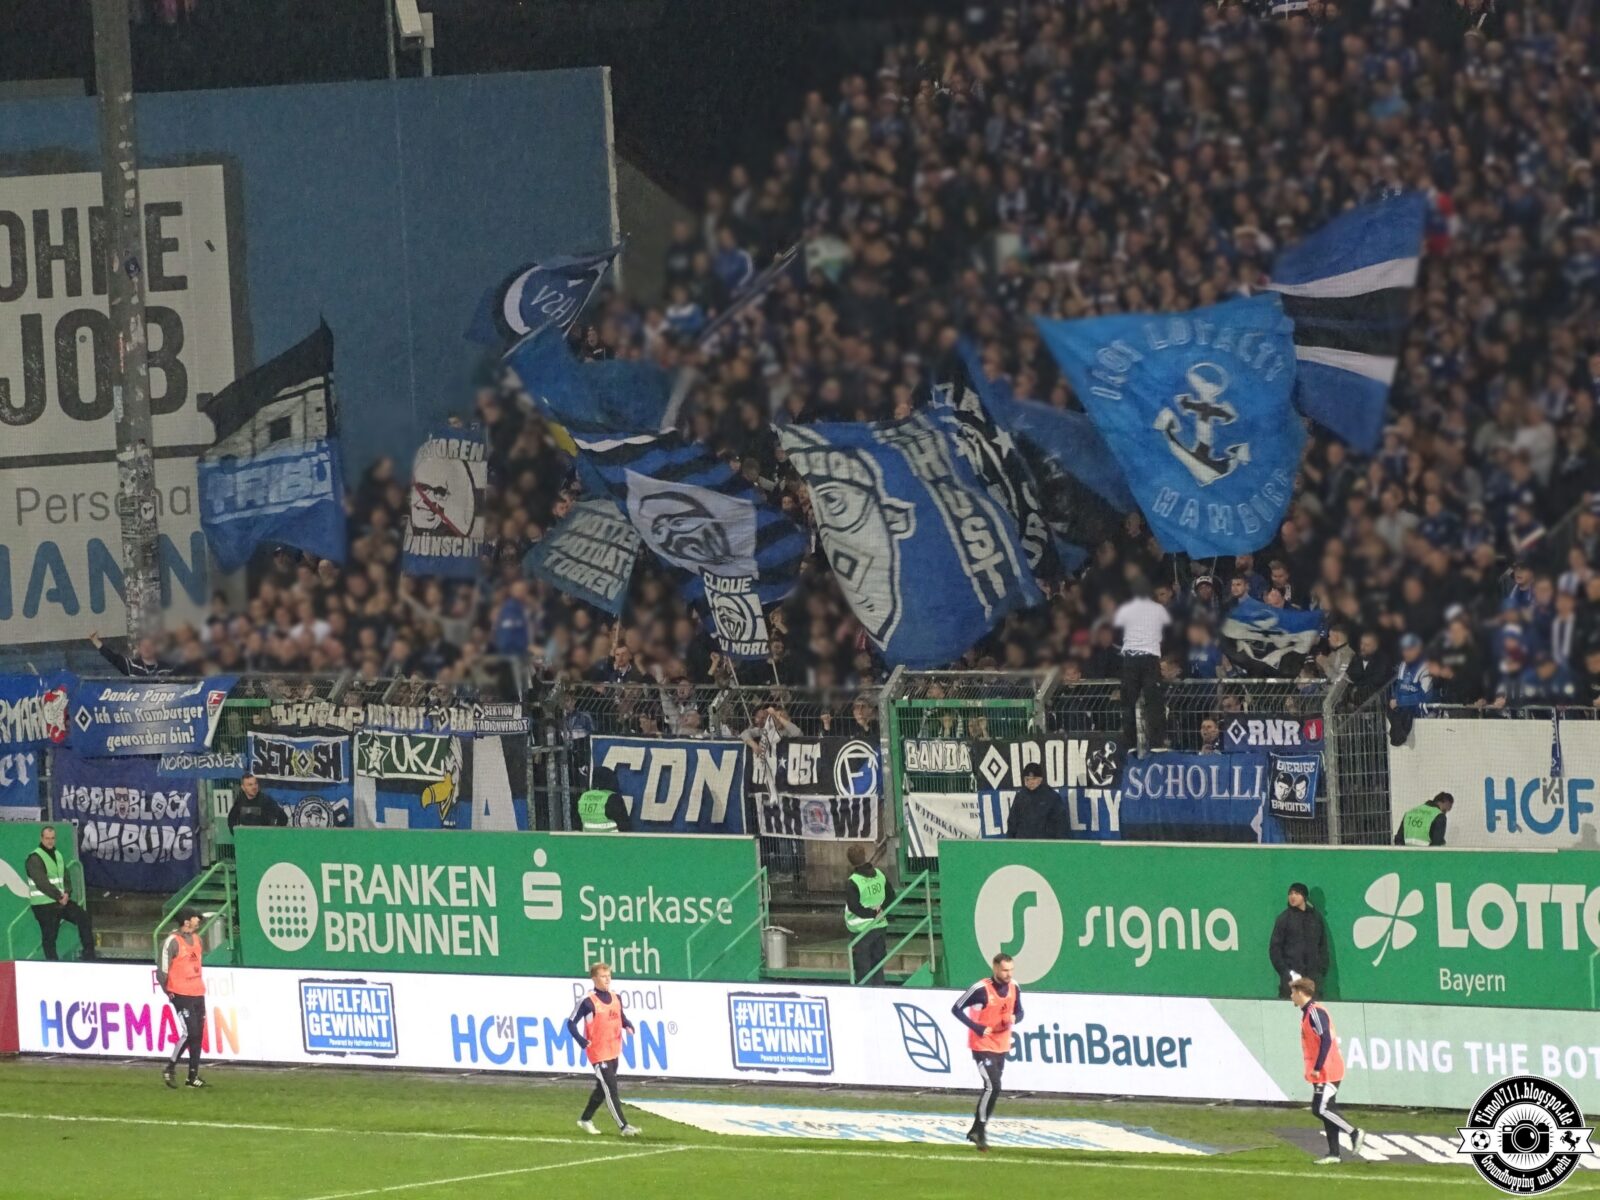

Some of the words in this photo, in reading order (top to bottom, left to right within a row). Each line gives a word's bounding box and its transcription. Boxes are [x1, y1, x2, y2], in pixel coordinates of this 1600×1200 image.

[99, 688, 140, 702] Danke
[142, 690, 176, 705] Papa
[94, 705, 111, 724] ich
[114, 707, 132, 724] ein
[134, 704, 203, 724] Hamburger
[107, 727, 167, 751] geworden
[170, 725, 195, 744] bin!
[1247, 719, 1301, 745] RNR
[905, 740, 972, 772] BANDA
[1124, 763, 1264, 800] SCHOLLI
[81, 820, 193, 864] AMBURG
[320, 862, 497, 908] FRANKEN
[579, 884, 733, 931] Sparkasse
[324, 911, 500, 957] BRUNNEN
[1078, 905, 1239, 968] signia
[582, 937, 661, 975] Fürth
[1439, 967, 1506, 997] Bayern
[306, 988, 388, 1014] #VIELFALT
[736, 1002, 823, 1029] #VIELFALT
[308, 1012, 389, 1038] GEWINNT
[738, 1027, 825, 1054] GEWINNT
[1009, 1023, 1192, 1069] artinBauer
[1346, 1037, 1453, 1074] ADING
[1464, 1041, 1529, 1076] THE
